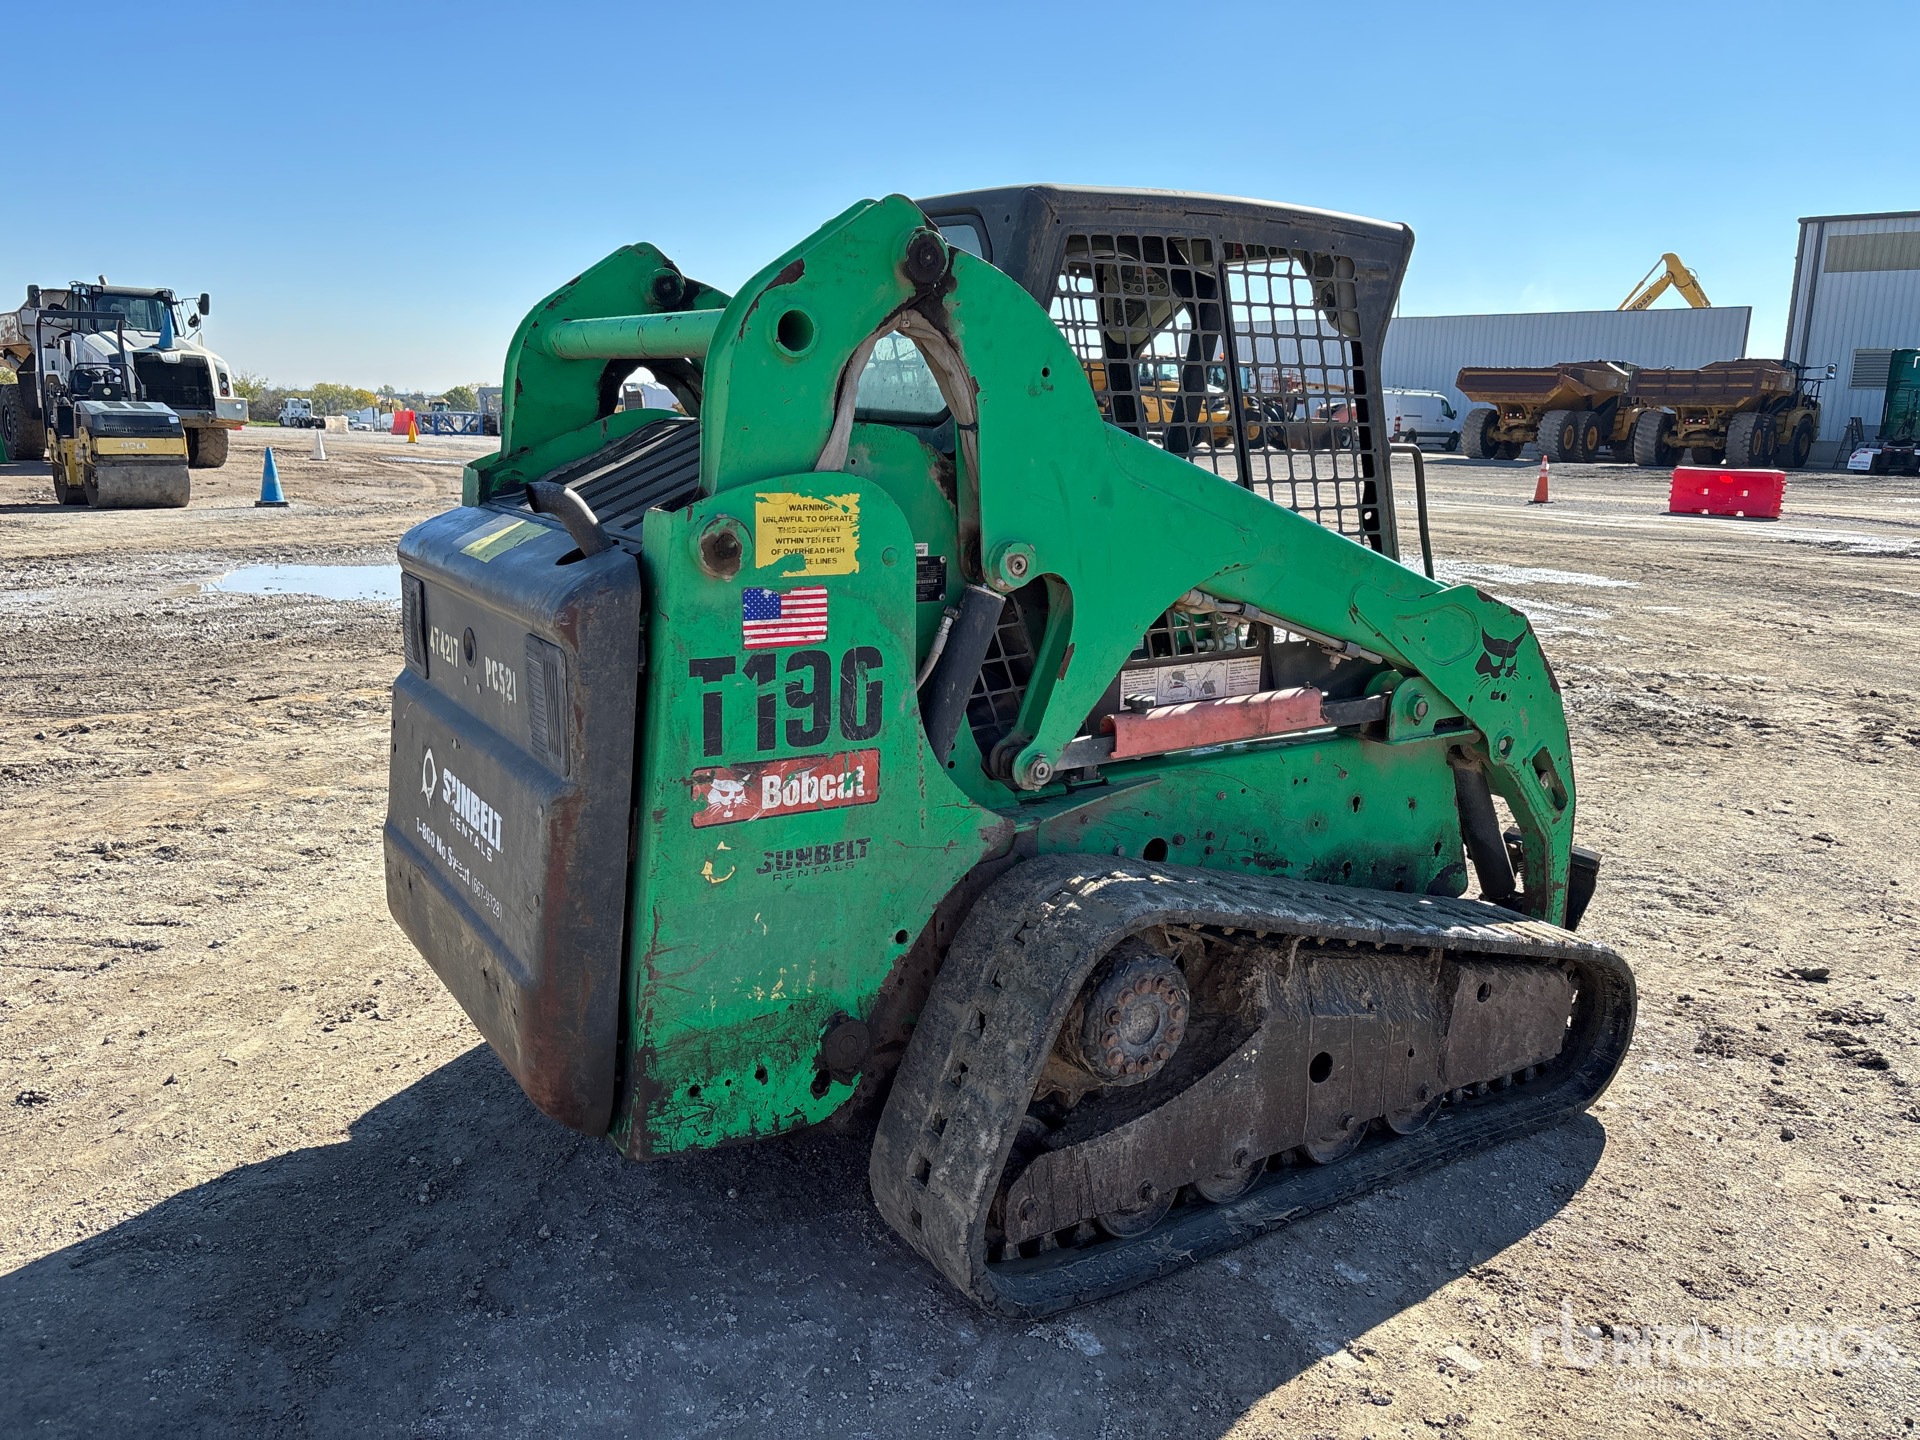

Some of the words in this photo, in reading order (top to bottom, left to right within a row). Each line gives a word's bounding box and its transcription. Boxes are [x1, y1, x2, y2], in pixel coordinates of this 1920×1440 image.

[762, 516, 804, 524] UNLAWFUL
[777, 526, 797, 534] THIS
[815, 557, 837, 565] LINES
[430, 625, 459, 668] 474217
[485, 656, 517, 704] PC521
[688, 646, 883, 757] T190
[761, 765, 865, 809] Bobcat
[442, 767, 503, 852] SUNBELT
[416, 816, 436, 848] 1-800
[436, 835, 446, 860] No
[449, 812, 493, 862] RENTALS
[756, 837, 871, 874] SUNBELT
[773, 861, 855, 881] RENTALS
